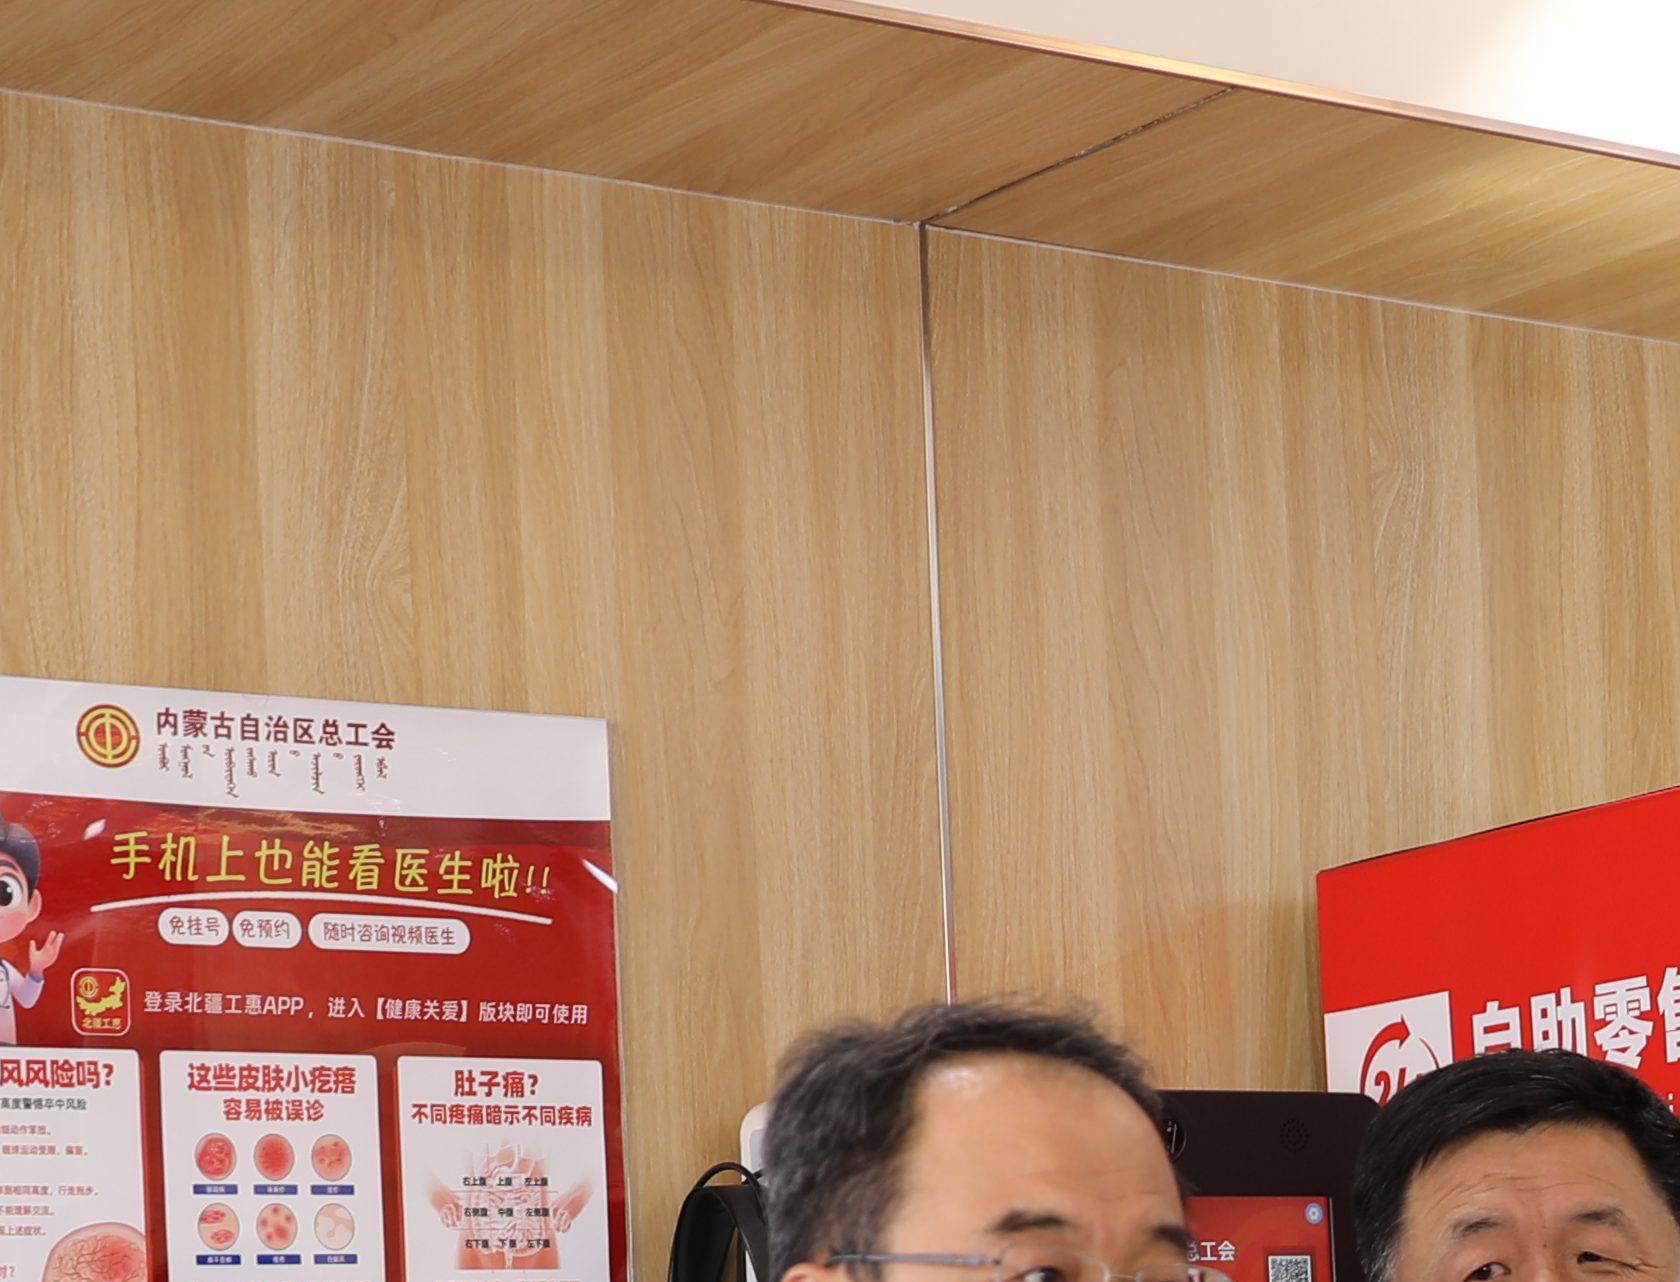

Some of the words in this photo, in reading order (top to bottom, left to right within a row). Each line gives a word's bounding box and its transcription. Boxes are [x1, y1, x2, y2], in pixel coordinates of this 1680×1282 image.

[156, 707, 396, 750] 内蒙古自治区总工会
[169, 917, 221, 938] 免挂号
[240, 920, 291, 940] 免预约
[322, 921, 456, 946] 随时咨询视频医生
[187, 1063, 357, 1095] 这些皮肤小疙瘩
[454, 1070, 539, 1098] 肚子痛？
[223, 1098, 325, 1122] 容易被误诊
[412, 1104, 593, 1127] 不同疼痛暗示不同疾病
